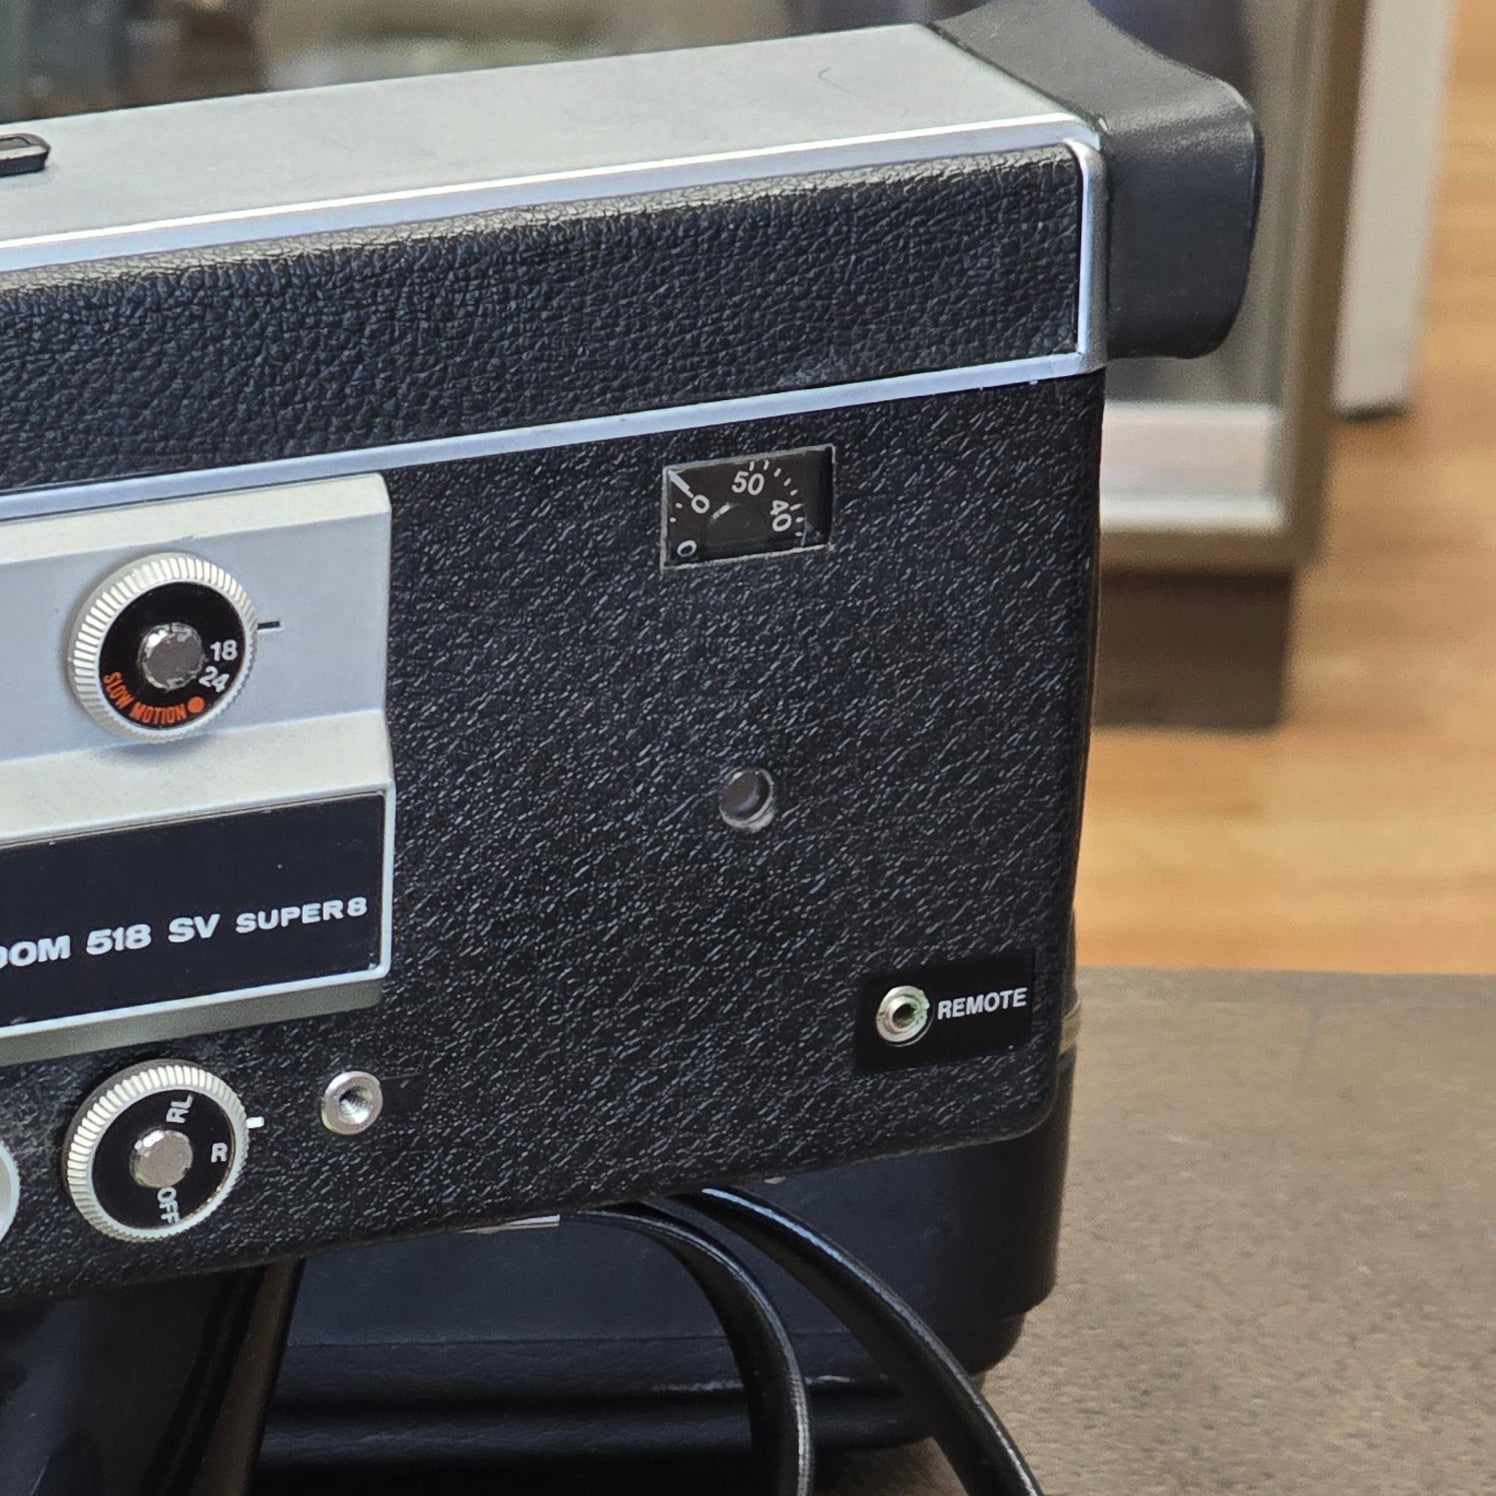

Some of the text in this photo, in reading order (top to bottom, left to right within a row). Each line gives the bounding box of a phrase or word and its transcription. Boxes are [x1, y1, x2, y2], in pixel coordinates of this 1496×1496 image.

[731, 470, 765, 496] 50
[690, 494, 710, 514] 0
[769, 499, 793, 533] 40
[209, 639, 238, 662] 18
[198, 666, 231, 693] 24
[104, 671, 188, 725] SLOW MOTION
[86, 924, 153, 956] 518
[167, 913, 221, 944] SV
[937, 987, 1028, 1021] REMOTE
[165, 1093, 194, 1124] RL
[210, 1142, 229, 1164] R
[156, 1186, 181, 1224] OFF
